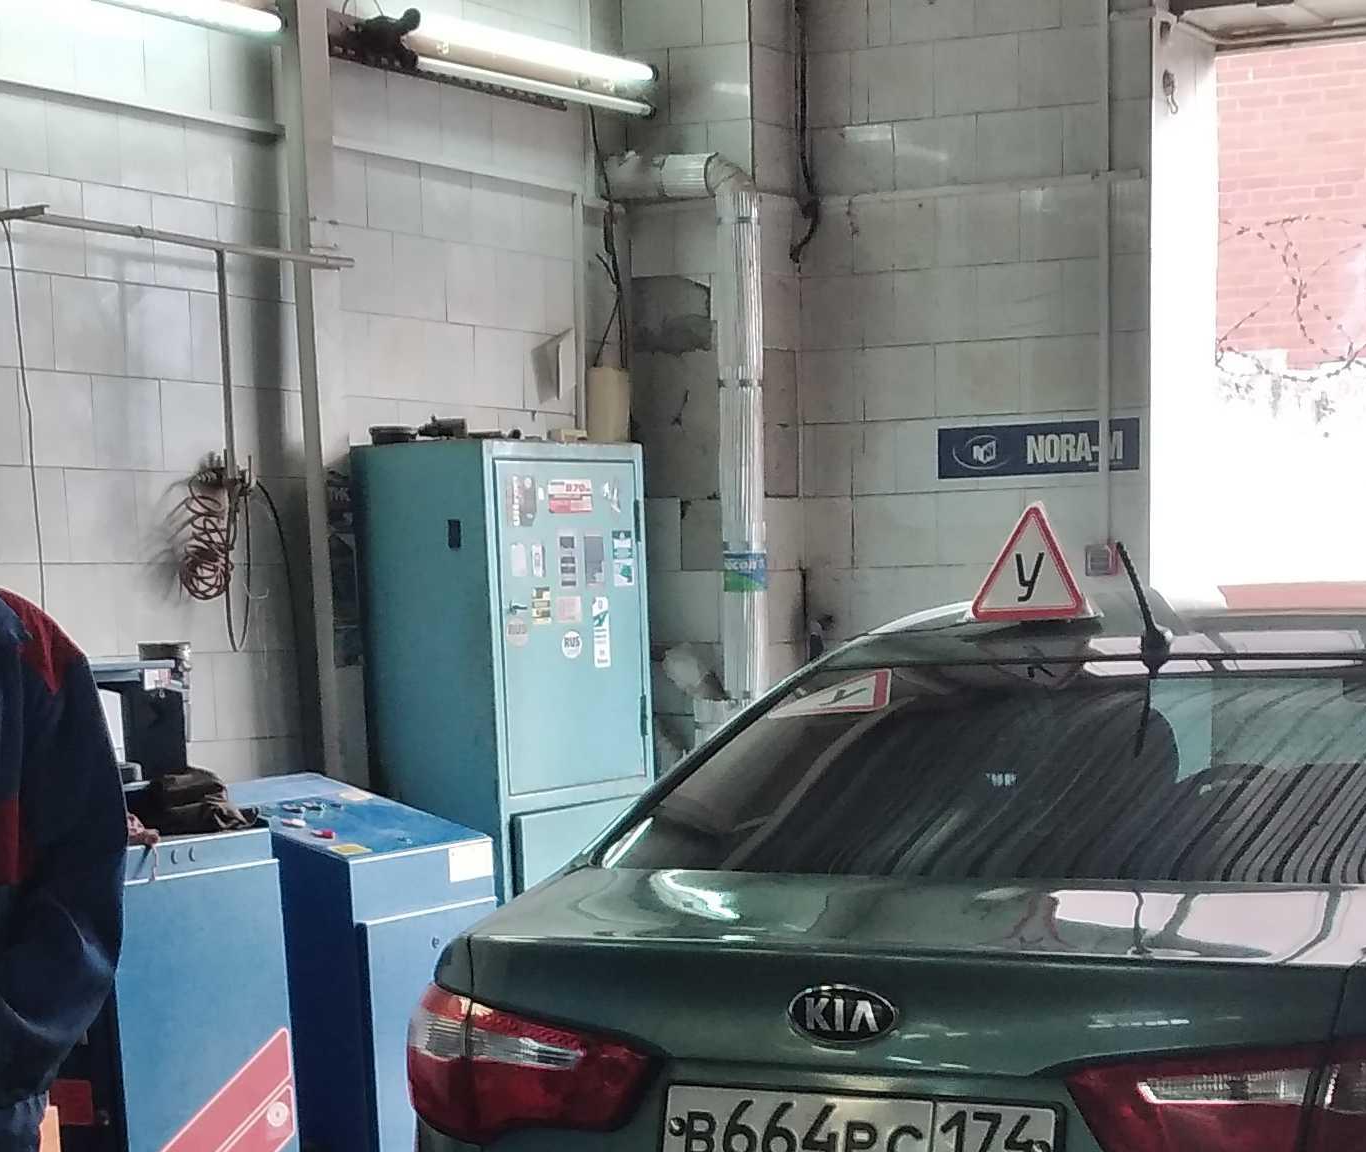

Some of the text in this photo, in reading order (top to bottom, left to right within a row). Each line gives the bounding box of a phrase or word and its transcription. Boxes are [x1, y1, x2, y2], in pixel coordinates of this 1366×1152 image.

[1026, 430, 1124, 465] NORA-M
[1015, 552, 1044, 602] У
[563, 635, 581, 648] RUS
[805, 997, 879, 1032] KIA
